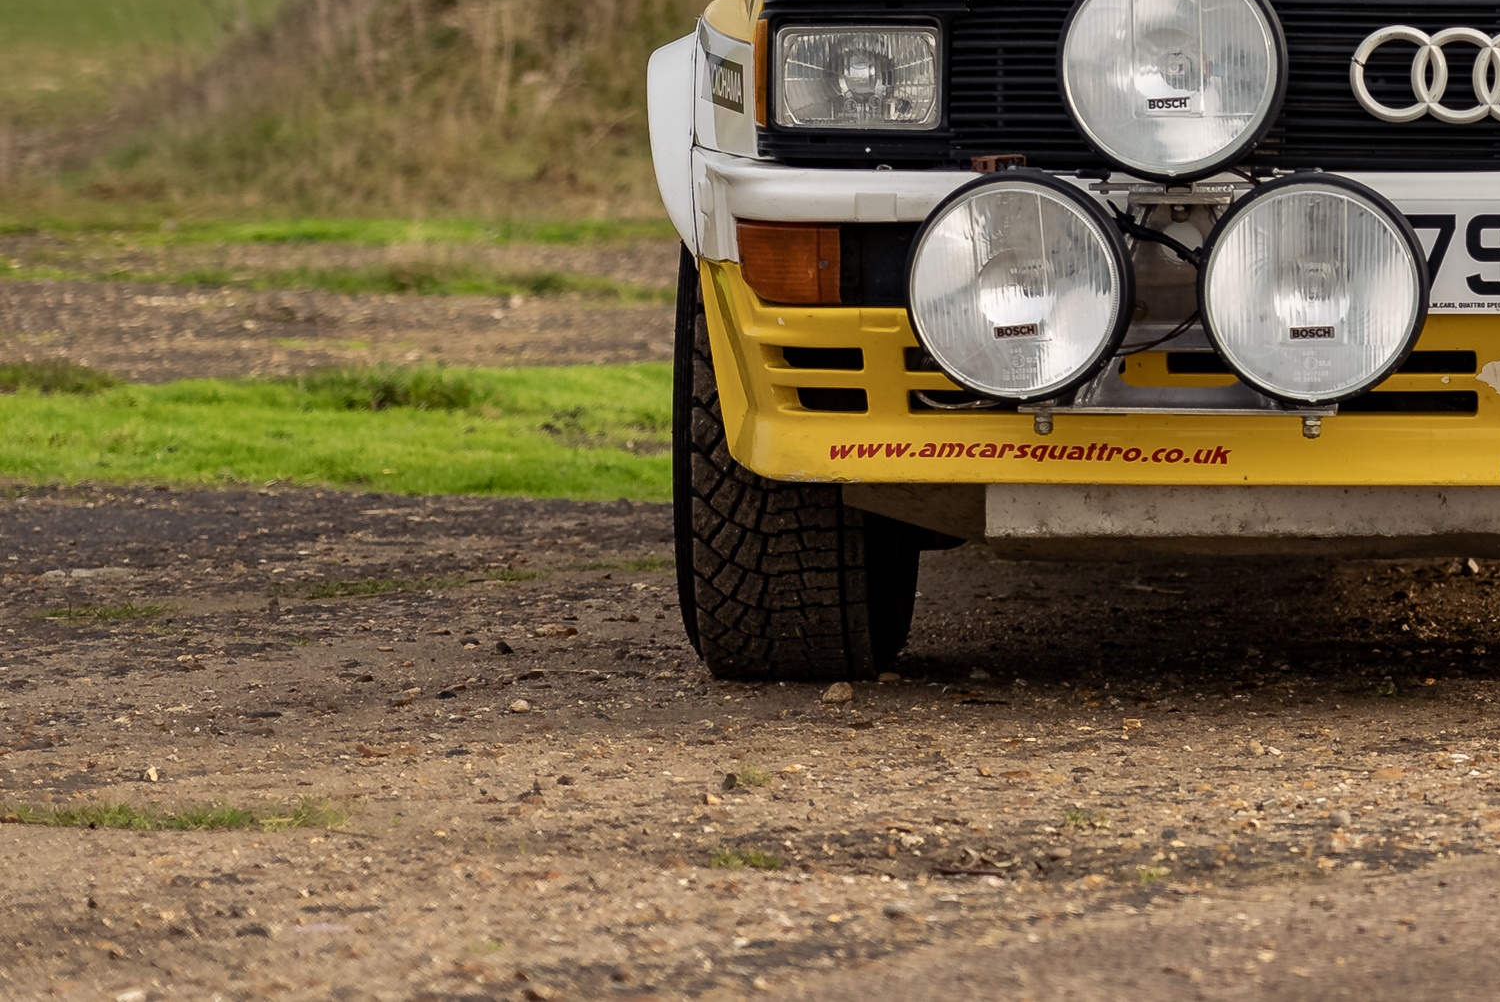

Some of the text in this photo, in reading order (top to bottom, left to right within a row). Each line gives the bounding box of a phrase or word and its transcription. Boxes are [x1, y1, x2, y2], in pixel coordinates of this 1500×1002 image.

[1148, 98, 1187, 109] BOSCH
[997, 325, 1035, 337] BOSCH
[1292, 328, 1331, 338] BOSCH
[829, 441, 1232, 465] www.amcarsquattro.co.uk
